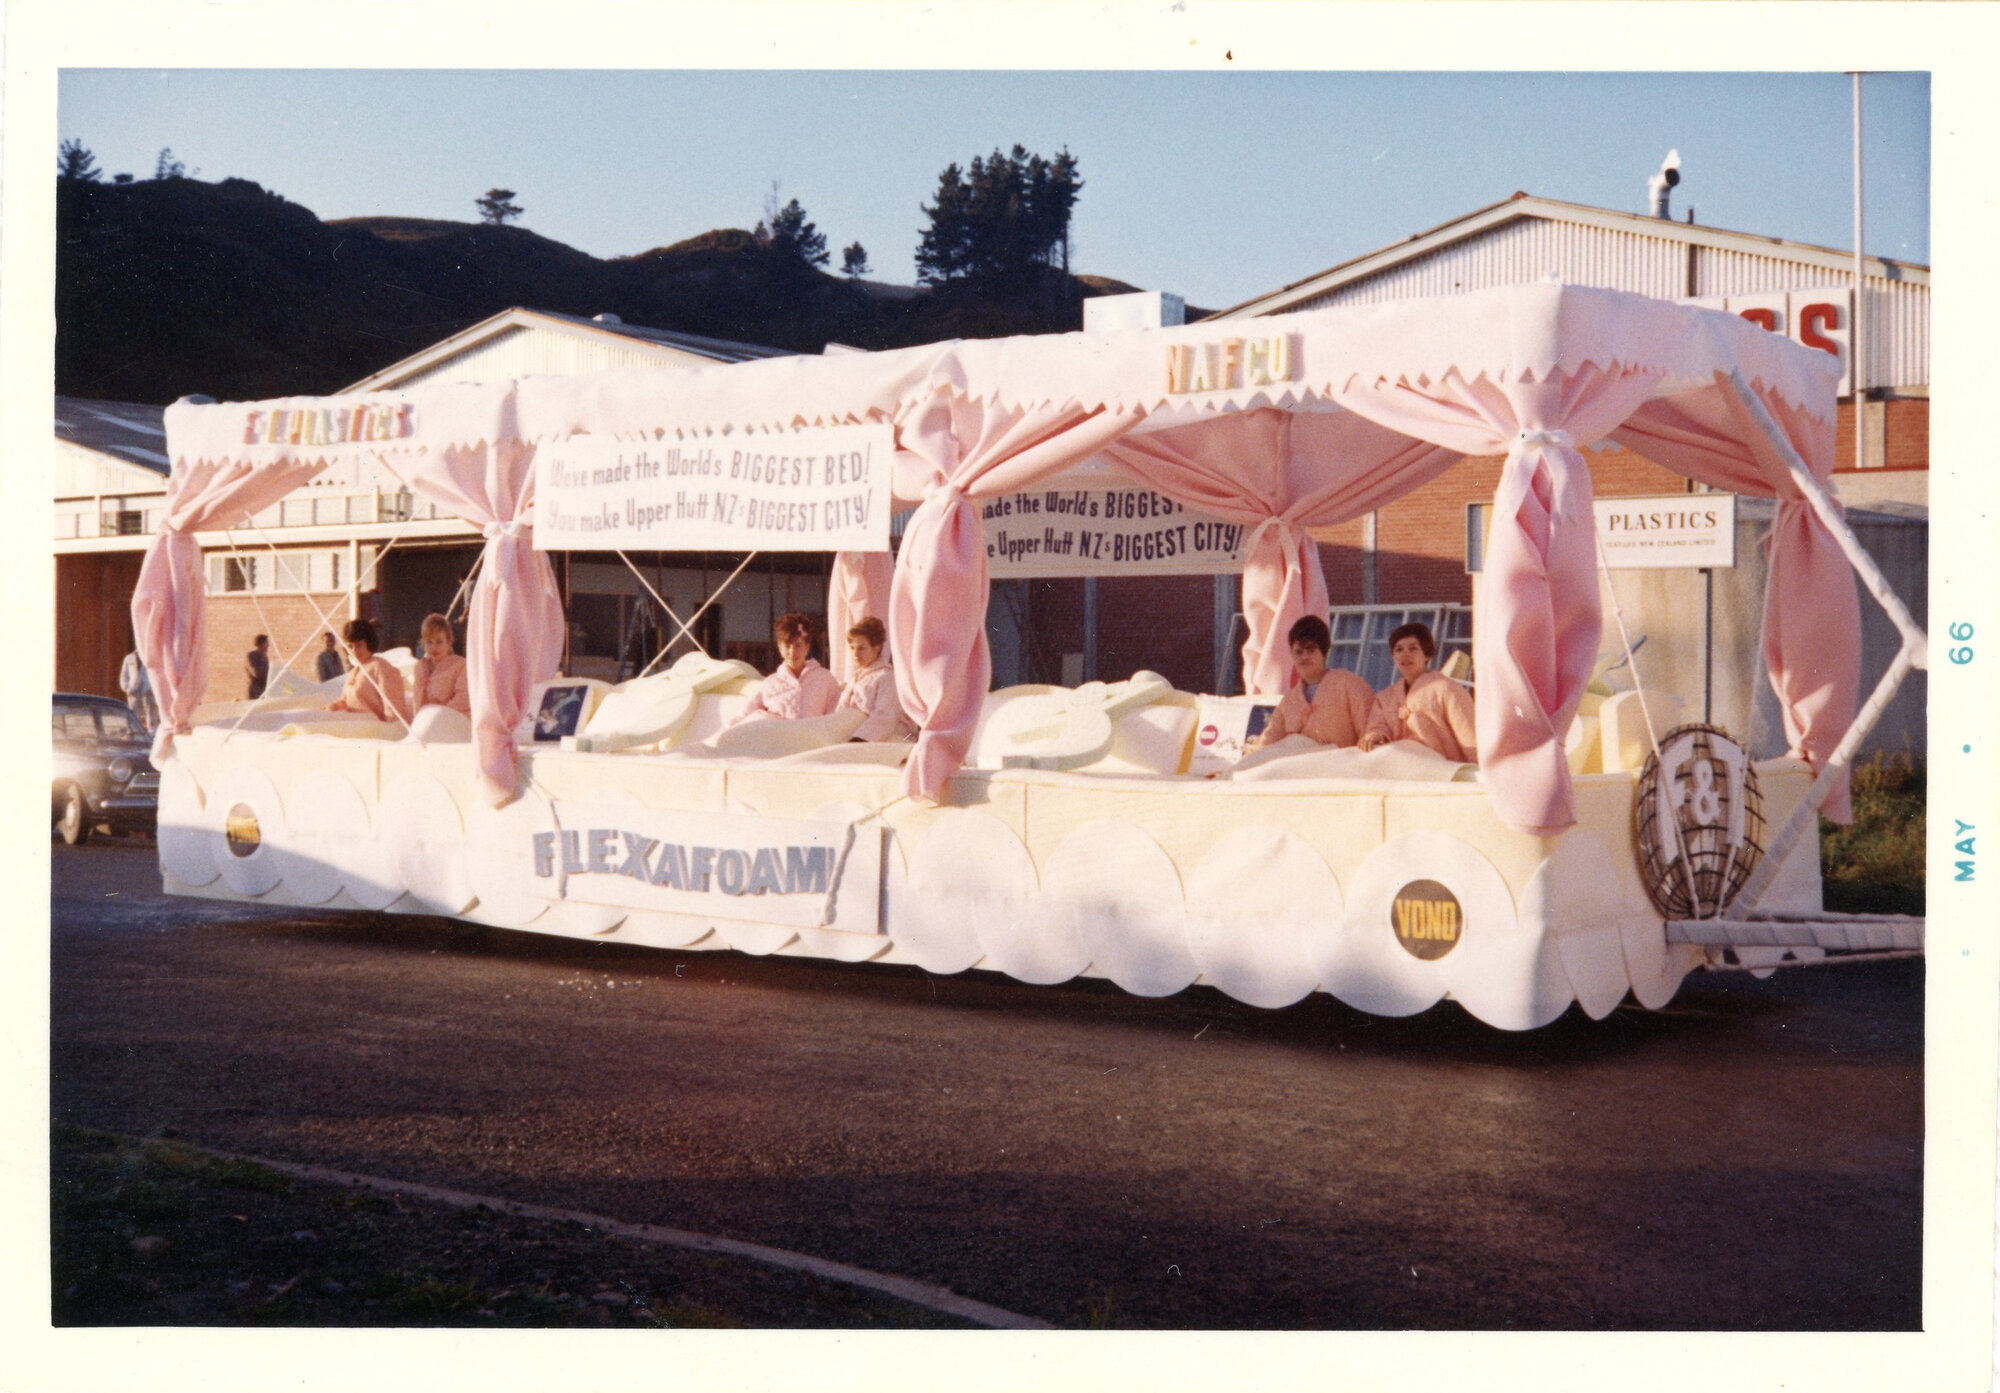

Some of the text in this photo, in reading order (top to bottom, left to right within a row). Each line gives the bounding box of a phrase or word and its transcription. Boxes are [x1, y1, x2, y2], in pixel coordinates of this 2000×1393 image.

[593, 454, 632, 485] made
[636, 451, 661, 480] the
[731, 450, 817, 487] BIGGEST
[825, 441, 872, 486] BED!
[548, 499, 577, 532] You
[580, 502, 621, 533] make
[625, 497, 672, 532] Upper
[676, 490, 709, 520] Hutt
[746, 498, 818, 533] BIGGEST
[825, 488, 872, 531] CITY!
[981, 497, 1012, 520] ade
[1016, 492, 1040, 514] the
[1609, 511, 1717, 531] PLASTICS
[998, 530, 1041, 562] Upper
[1043, 527, 1074, 555] Hutt
[1113, 526, 1186, 562] BIGGEST
[1193, 522, 1244, 560] CITY!
[532, 829, 836, 896] FLEXAFOAM
